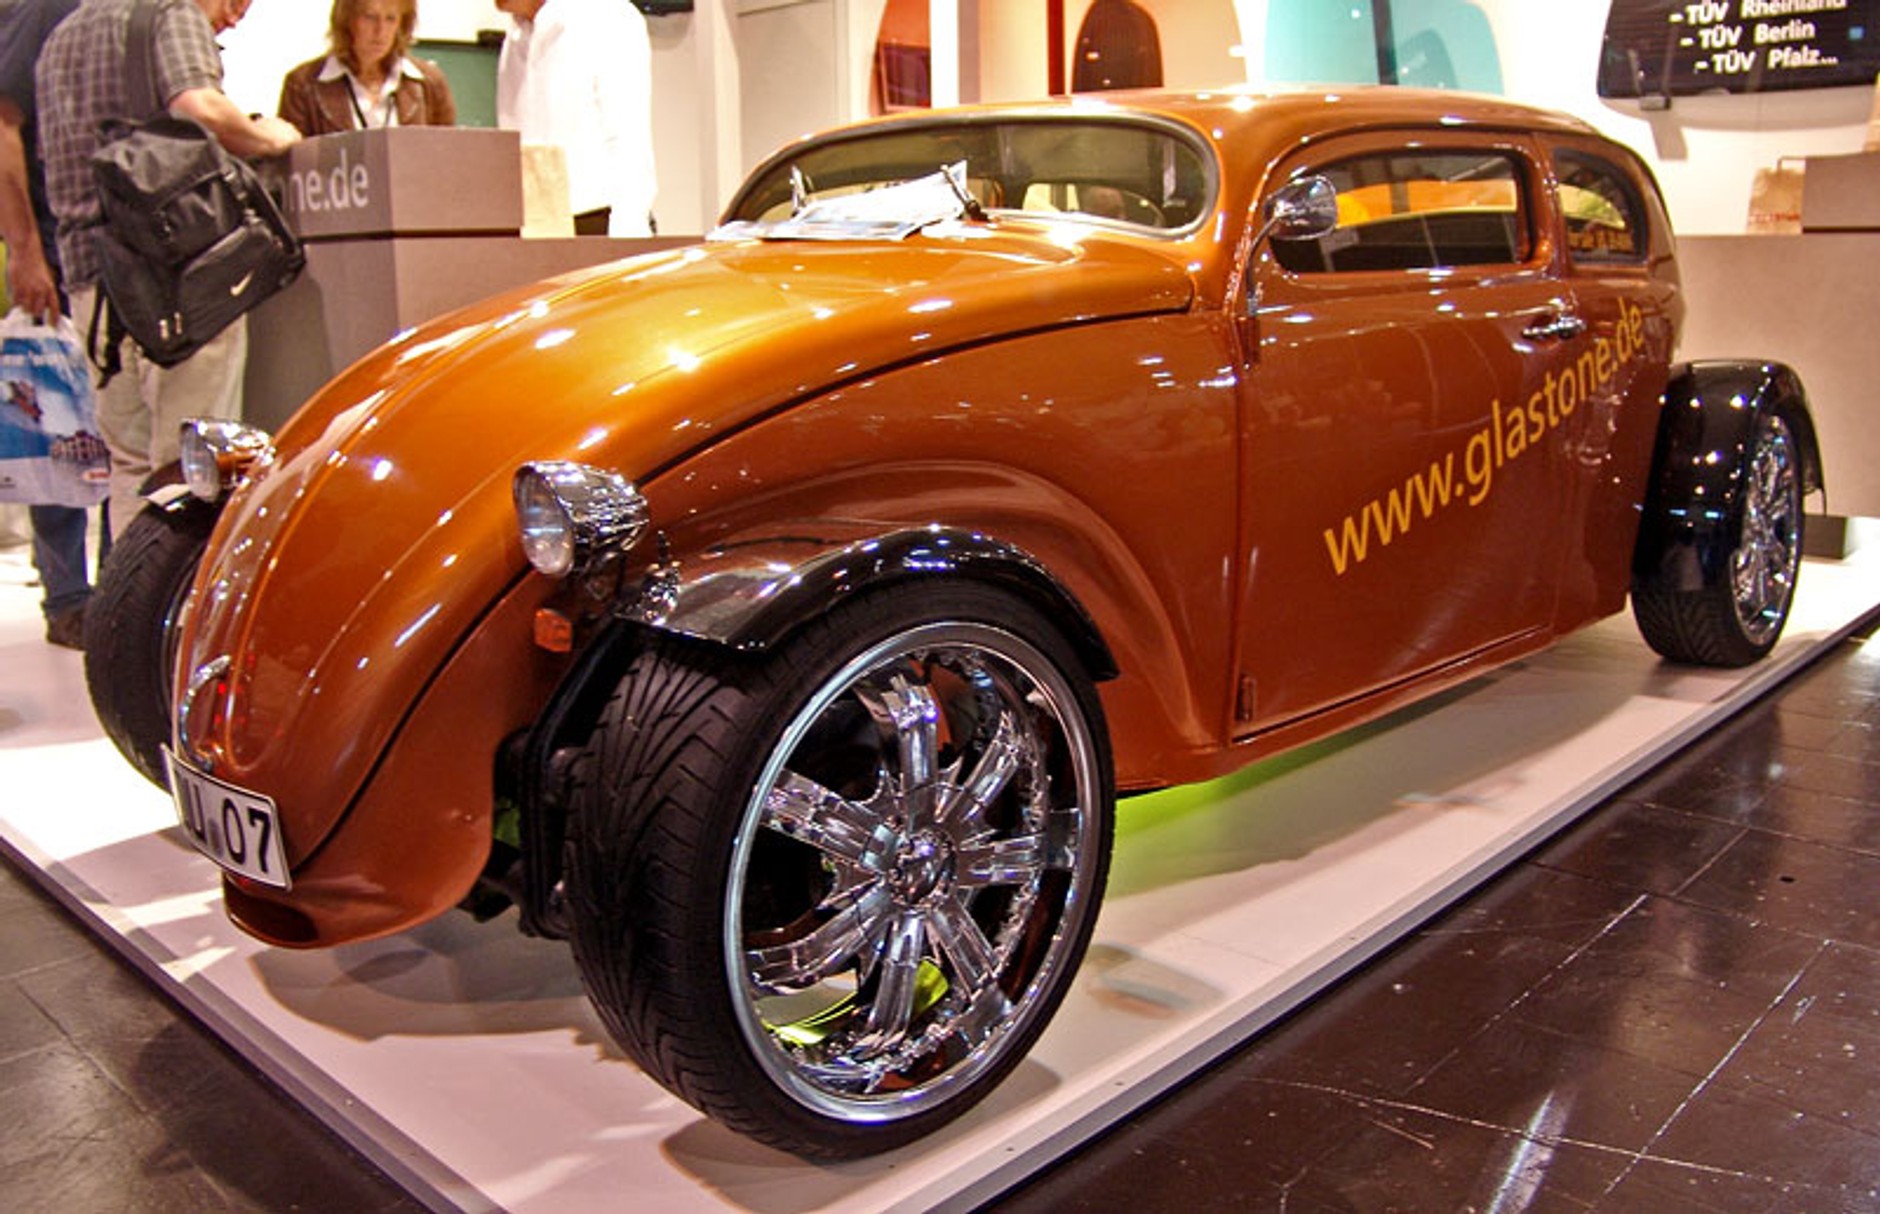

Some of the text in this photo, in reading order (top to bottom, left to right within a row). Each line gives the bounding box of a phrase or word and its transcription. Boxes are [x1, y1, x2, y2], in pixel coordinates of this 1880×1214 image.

[1754, 18, 1815, 44] Berlin
[1323, 296, 1645, 576] www.glastone.de
[222, 797, 271, 874] 07
